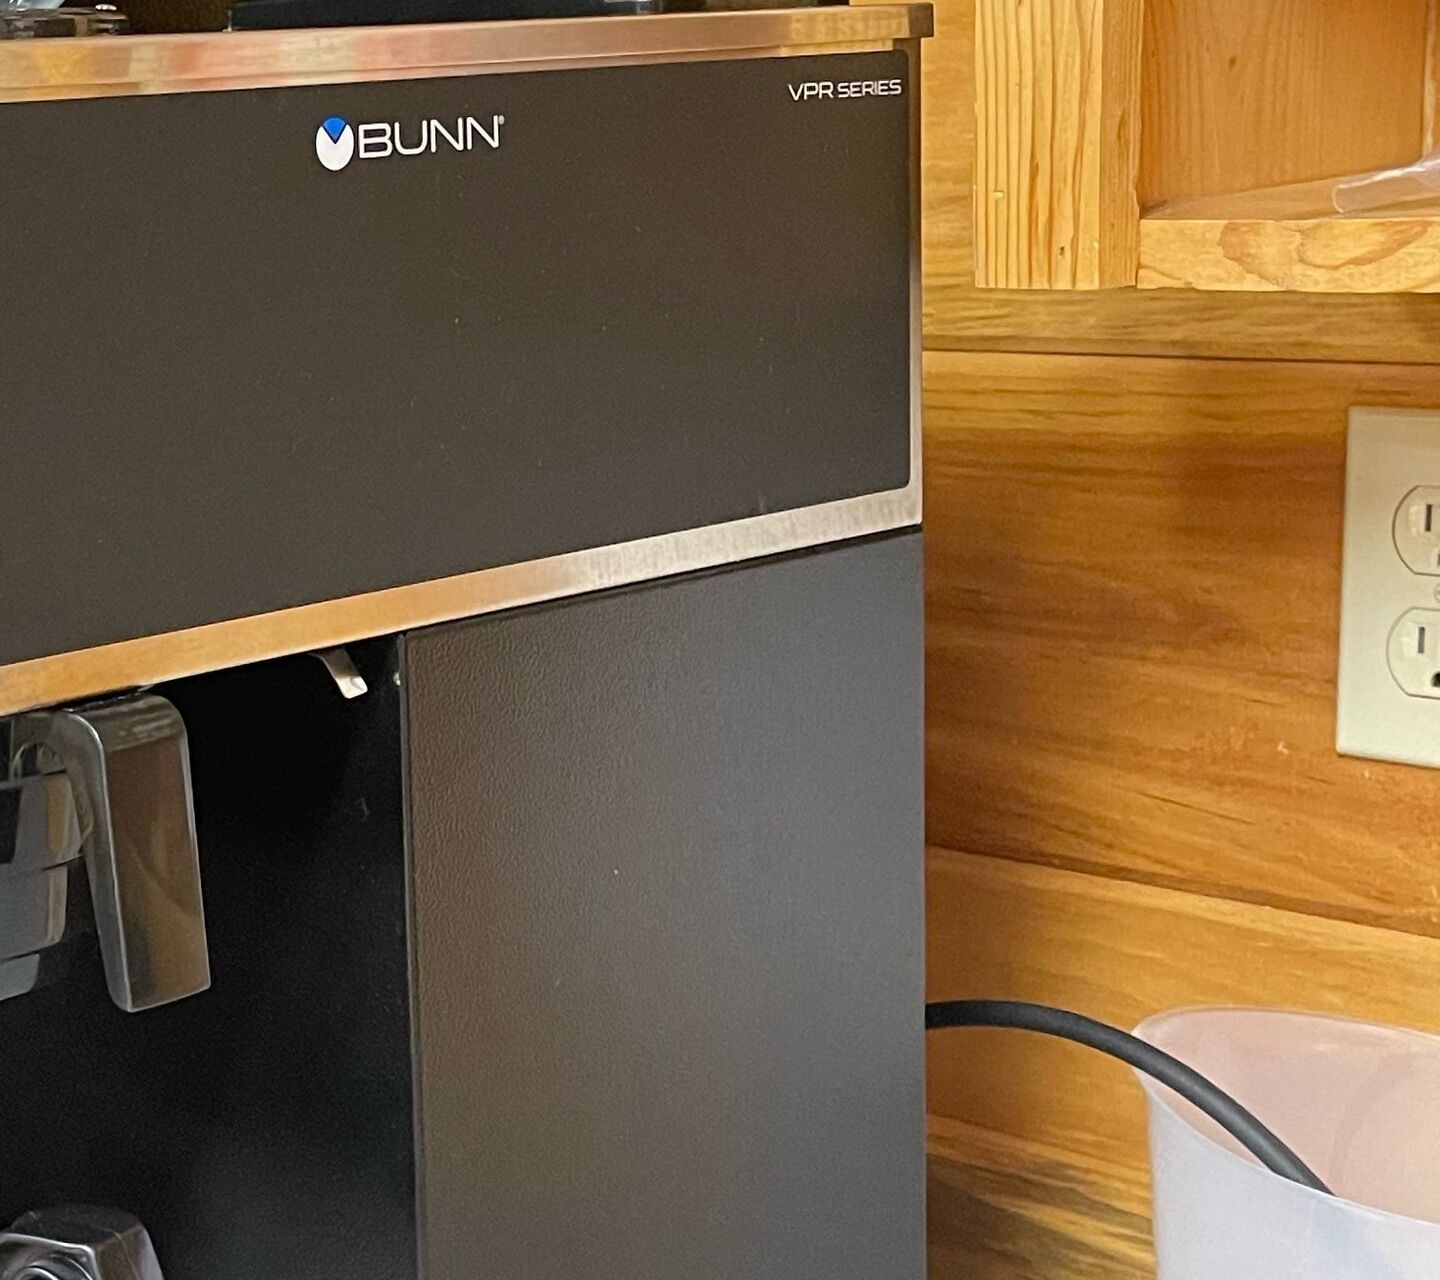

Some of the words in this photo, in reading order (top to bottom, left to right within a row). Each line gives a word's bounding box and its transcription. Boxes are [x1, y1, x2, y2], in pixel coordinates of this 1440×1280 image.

[788, 81, 834, 100] VPR
[837, 79, 902, 98] SERIES
[358, 115, 500, 159] BUNN
